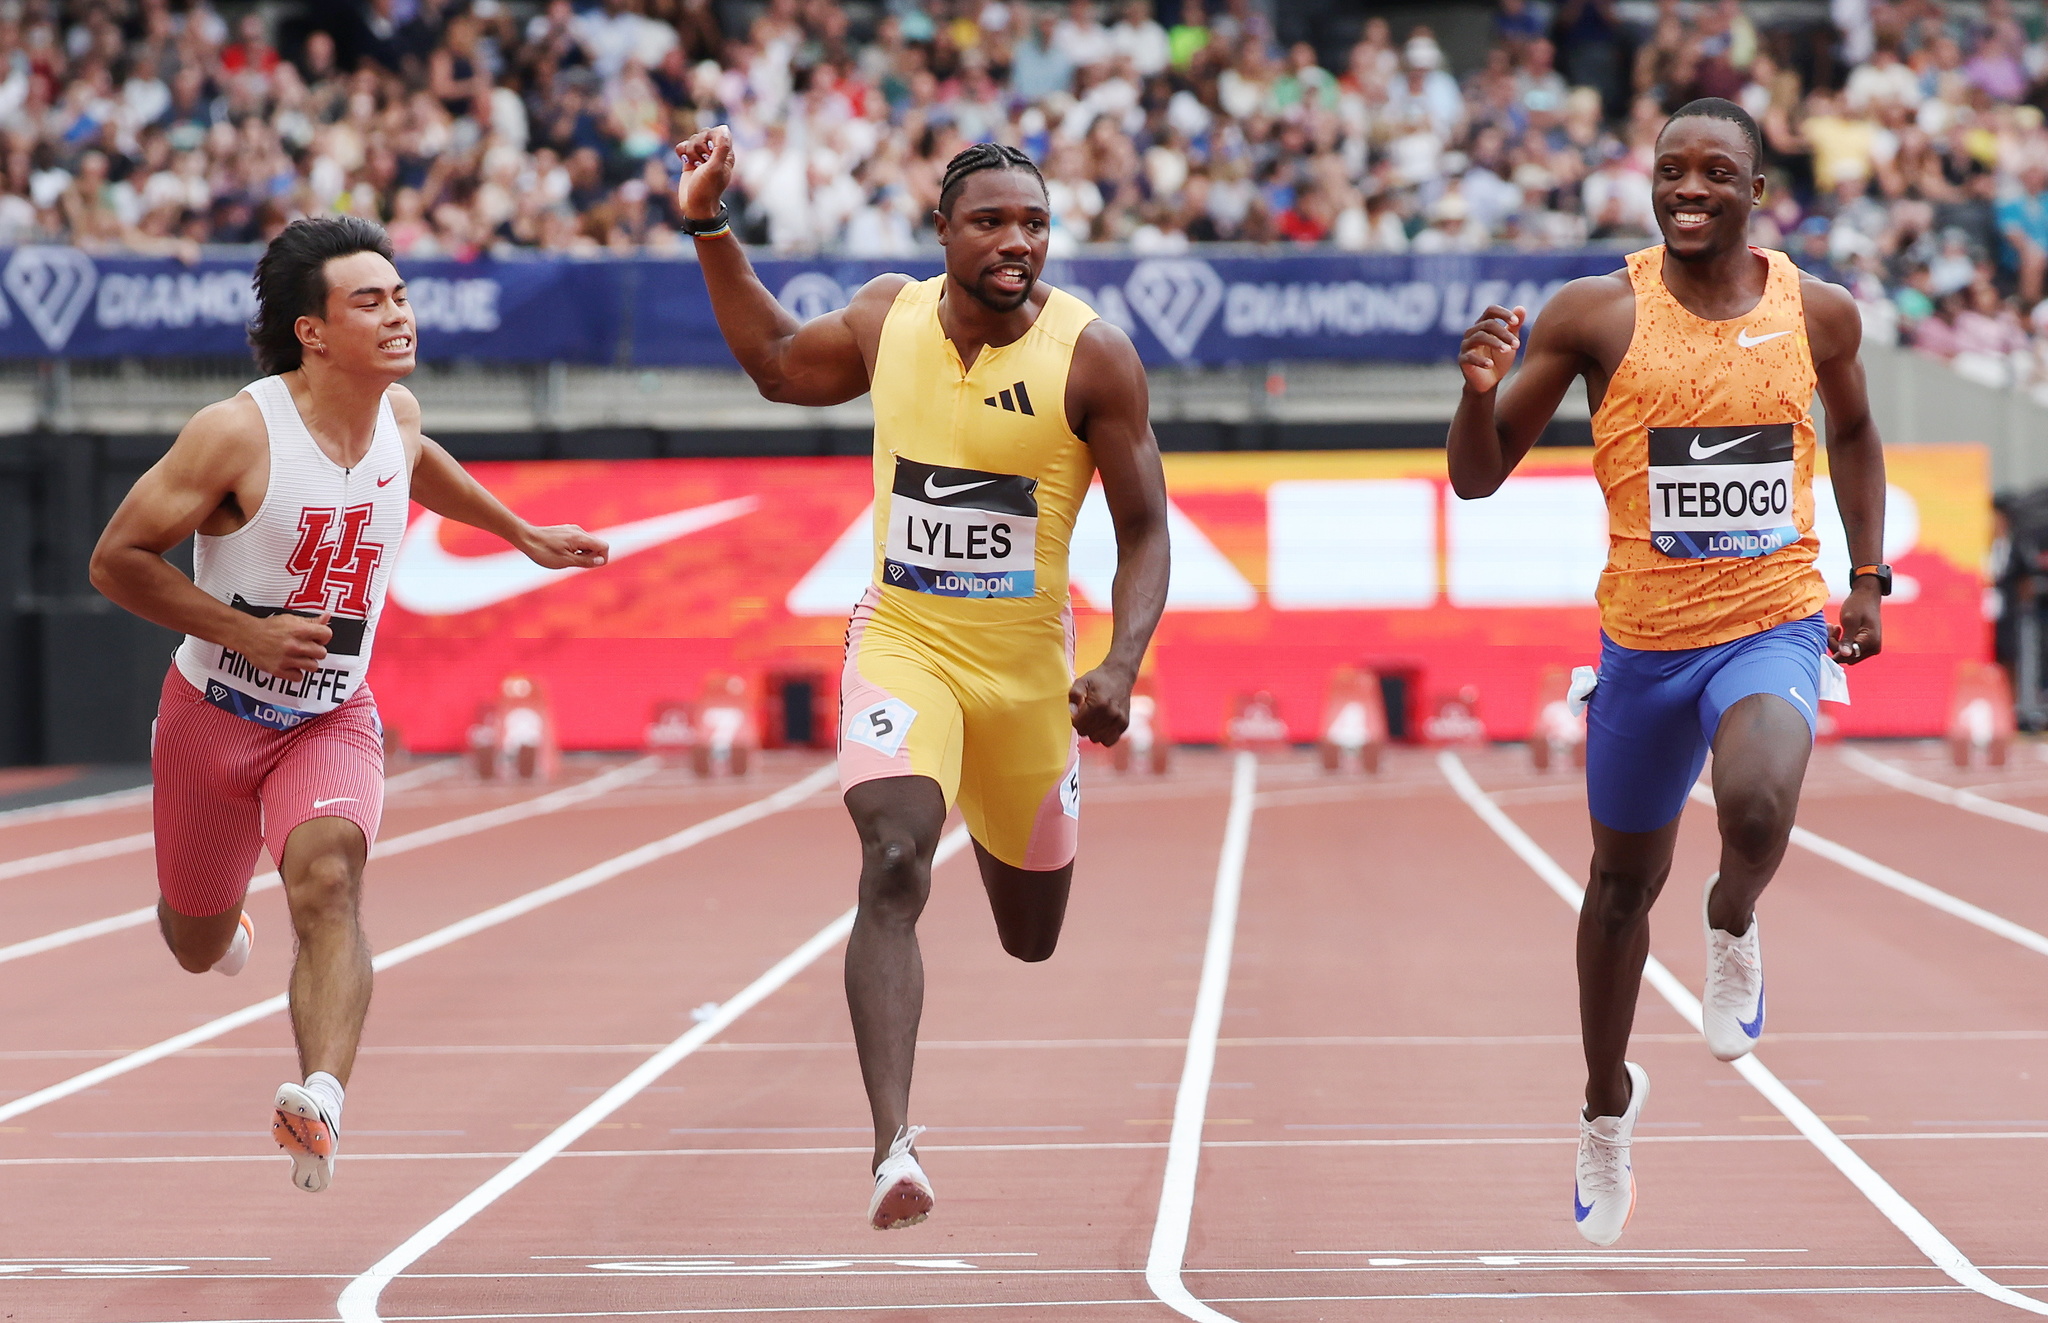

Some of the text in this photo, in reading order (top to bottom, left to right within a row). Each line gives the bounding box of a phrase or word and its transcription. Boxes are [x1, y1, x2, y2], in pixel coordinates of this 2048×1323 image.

[97, 273, 260, 329] DIAMO
[1222, 279, 1435, 337] DIAMOND
[1656, 478, 1787, 518] TEBOGO
[907, 515, 1012, 560] LYLES
[1708, 533, 1783, 552] LONDON
[935, 575, 1014, 593] LONDON
[254, 704, 313, 727] LOND
[869, 708, 894, 738] 5
[1070, 772, 1078, 804] 5
